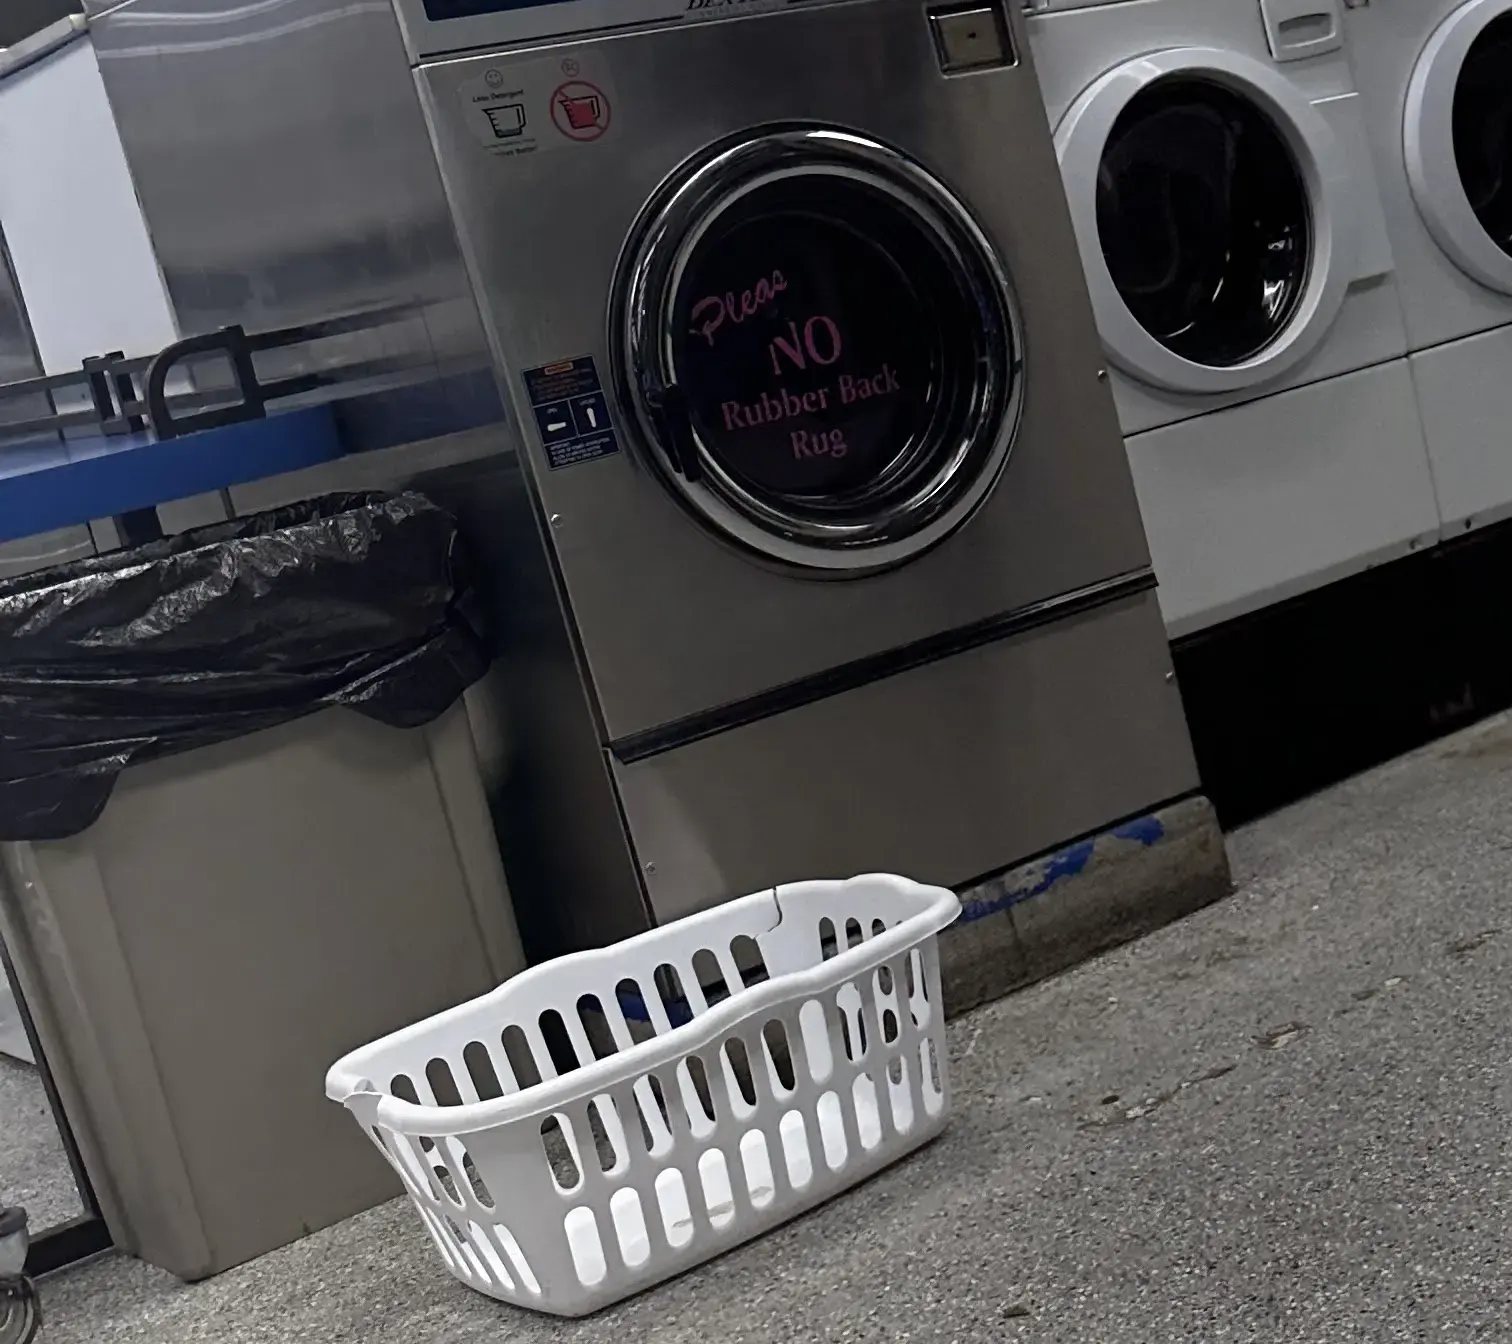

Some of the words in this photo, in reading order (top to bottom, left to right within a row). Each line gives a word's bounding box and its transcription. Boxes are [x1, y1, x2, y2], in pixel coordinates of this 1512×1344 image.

[768, 315, 842, 376] NO
[720, 387, 830, 431] Rubber
[837, 363, 901, 405] Back
[789, 428, 850, 460] Rug
